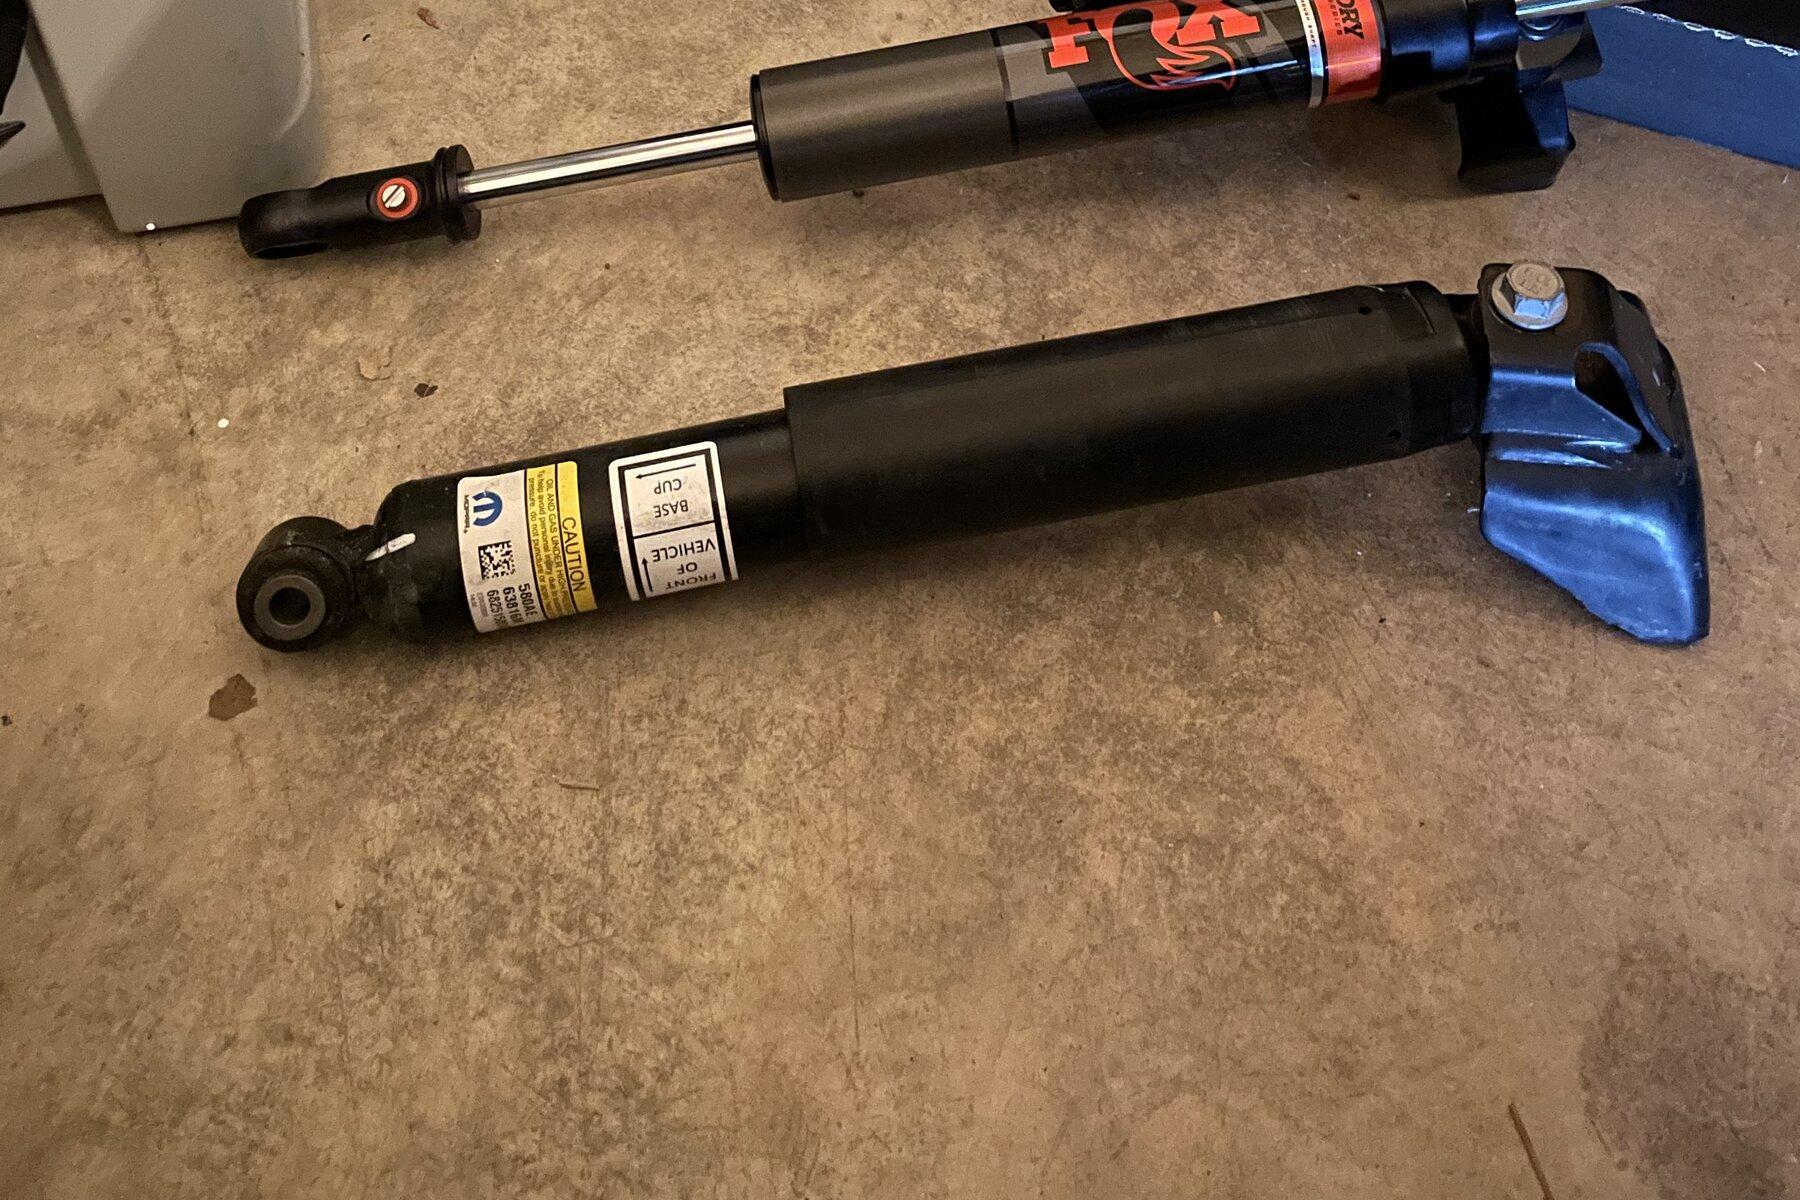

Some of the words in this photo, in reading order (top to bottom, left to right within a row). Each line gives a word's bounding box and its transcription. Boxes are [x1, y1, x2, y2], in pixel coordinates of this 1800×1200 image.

[546, 478, 554, 492] OIL
[653, 478, 682, 495] CUP
[538, 494, 546, 515] avoid
[547, 493, 556, 511] AND
[652, 499, 689, 518] BASE
[530, 511, 537, 522] do
[548, 513, 558, 533] GAS
[531, 523, 539, 537] not
[539, 517, 550, 552] personal
[532, 539, 544, 574] puncture
[551, 535, 562, 569] UNDER
[561, 516, 587, 592] CAUTION
[651, 538, 716, 563] VEHICLE
[676, 561, 698, 575] OF
[556, 569, 568, 590] HIGH
[665, 572, 717, 590] FRONT
[518, 583, 538, 617] 580AE
